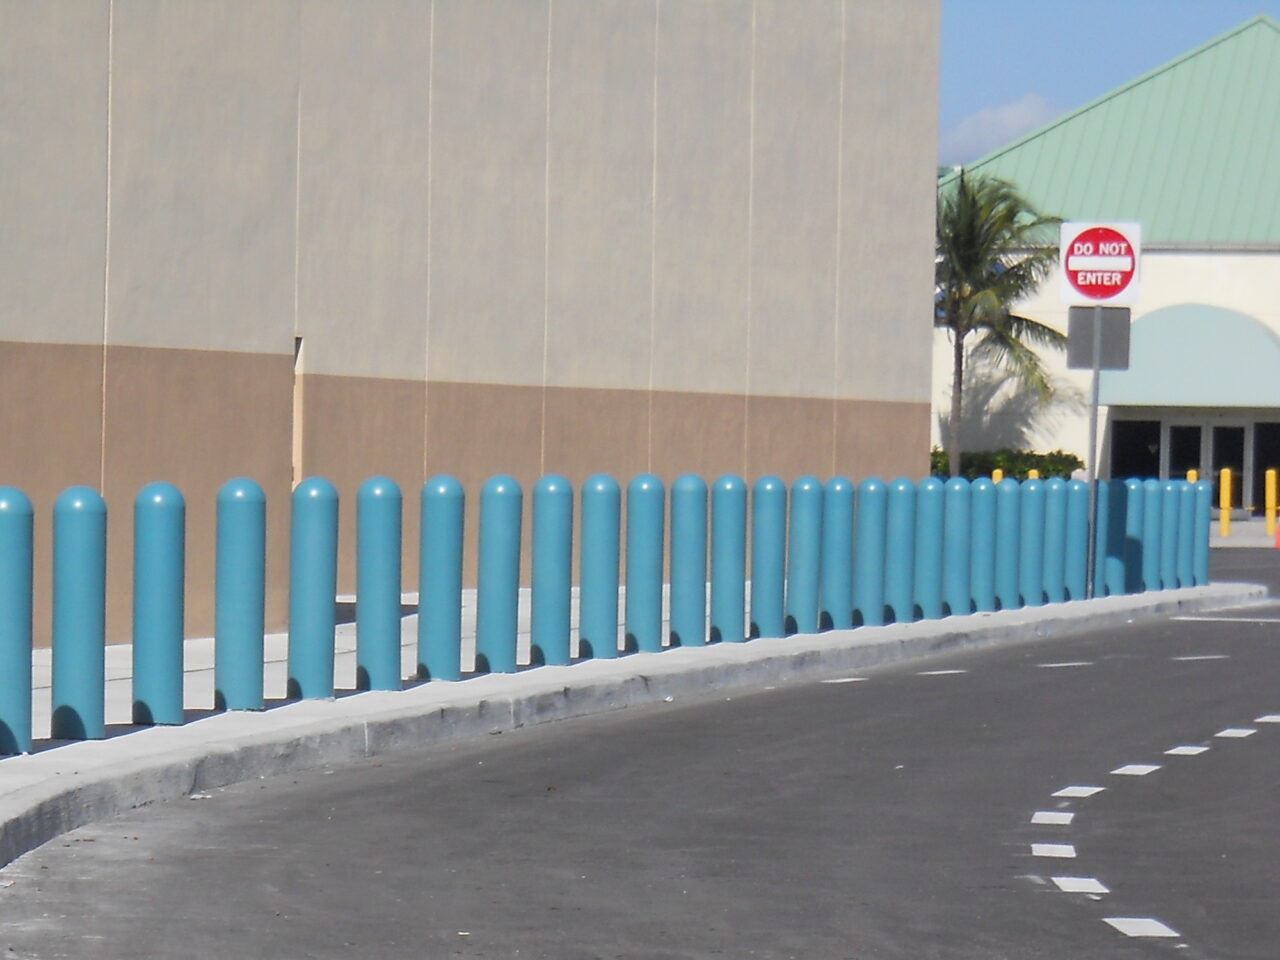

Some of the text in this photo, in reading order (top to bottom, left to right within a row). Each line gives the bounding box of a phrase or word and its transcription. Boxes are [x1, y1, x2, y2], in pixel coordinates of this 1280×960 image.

[1074, 242, 1127, 255] DO NOT
[1077, 272, 1121, 285] ENTER
